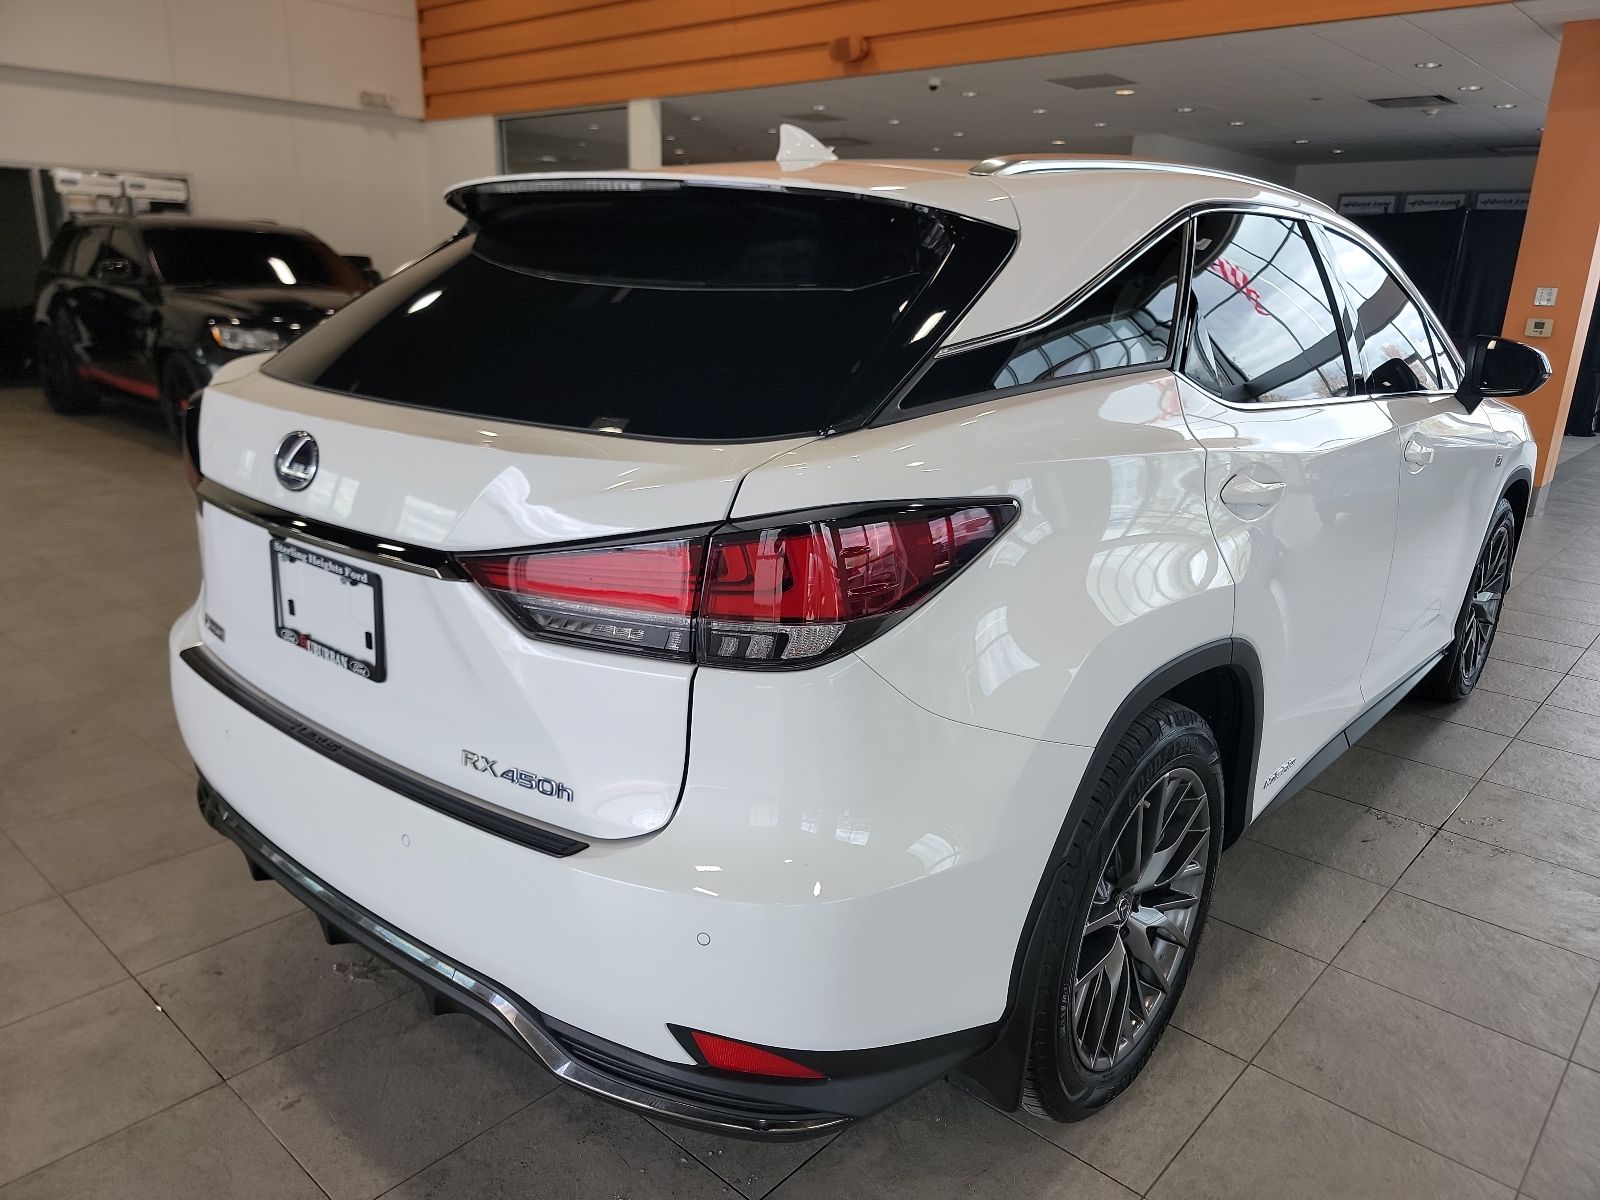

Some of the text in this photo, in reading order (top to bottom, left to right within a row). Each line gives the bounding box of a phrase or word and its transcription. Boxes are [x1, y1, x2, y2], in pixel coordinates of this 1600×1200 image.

[273, 541, 369, 584] Sterling Heights Ford
